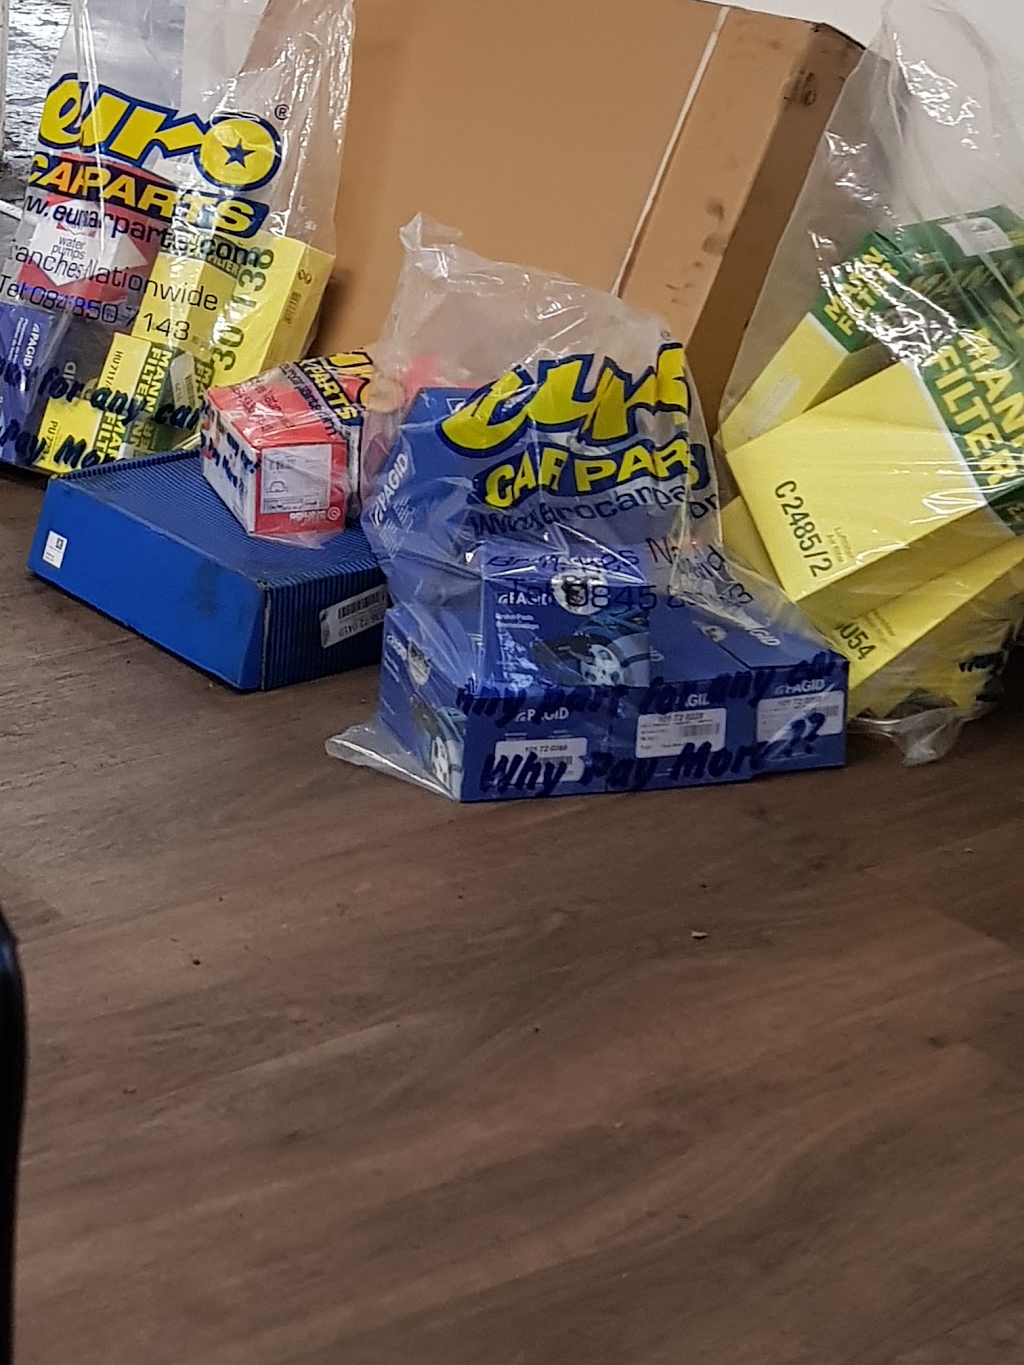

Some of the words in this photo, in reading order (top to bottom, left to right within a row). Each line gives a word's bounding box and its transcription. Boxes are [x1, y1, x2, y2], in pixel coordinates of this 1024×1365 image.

[38, 72, 282, 192] euro
[50, 244, 86, 261] pumps
[58, 235, 86, 250] water
[22, 329, 40, 368] PAGID
[90, 387, 146, 425] any
[149, 349, 173, 413] MANN
[932, 345, 1017, 486] FILTER
[377, 451, 409, 512] PAGID
[484, 449, 570, 510] CAR
[480, 751, 567, 798] Why
